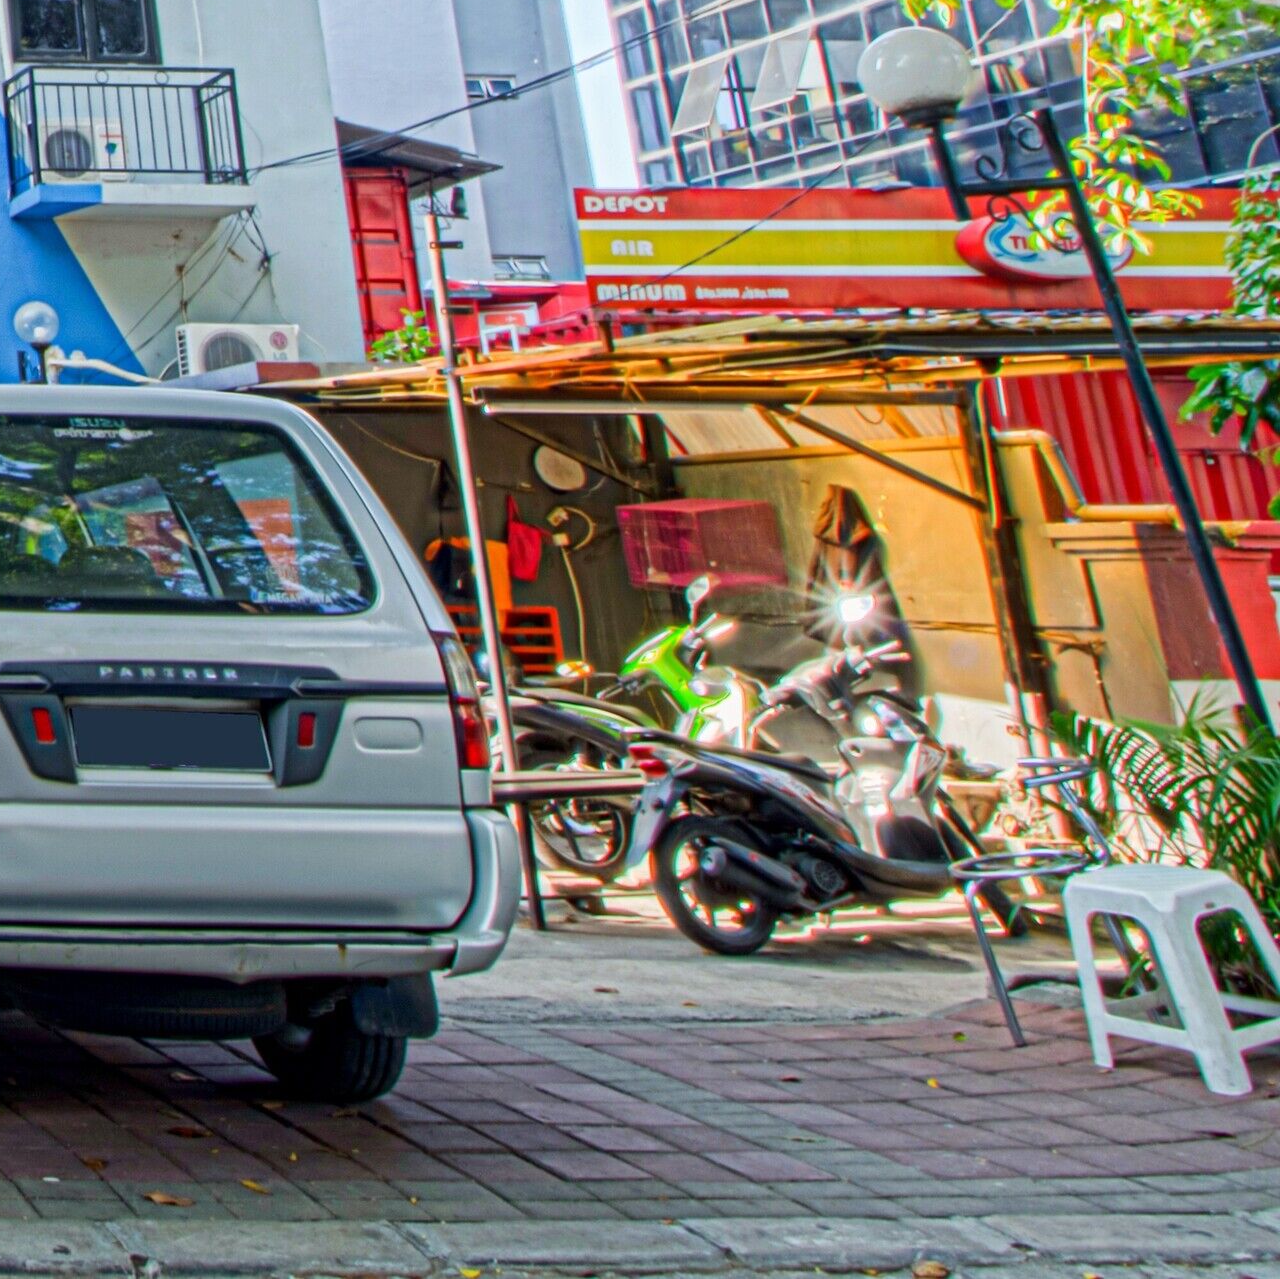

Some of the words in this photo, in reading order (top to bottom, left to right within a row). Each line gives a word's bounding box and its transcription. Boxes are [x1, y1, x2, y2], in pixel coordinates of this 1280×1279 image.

[583, 195, 669, 213] DEPOT
[610, 239, 654, 256] AIR
[596, 283, 687, 301] MINUM
[69, 417, 126, 429] ISUZU
[98, 666, 239, 681] PANTHER
